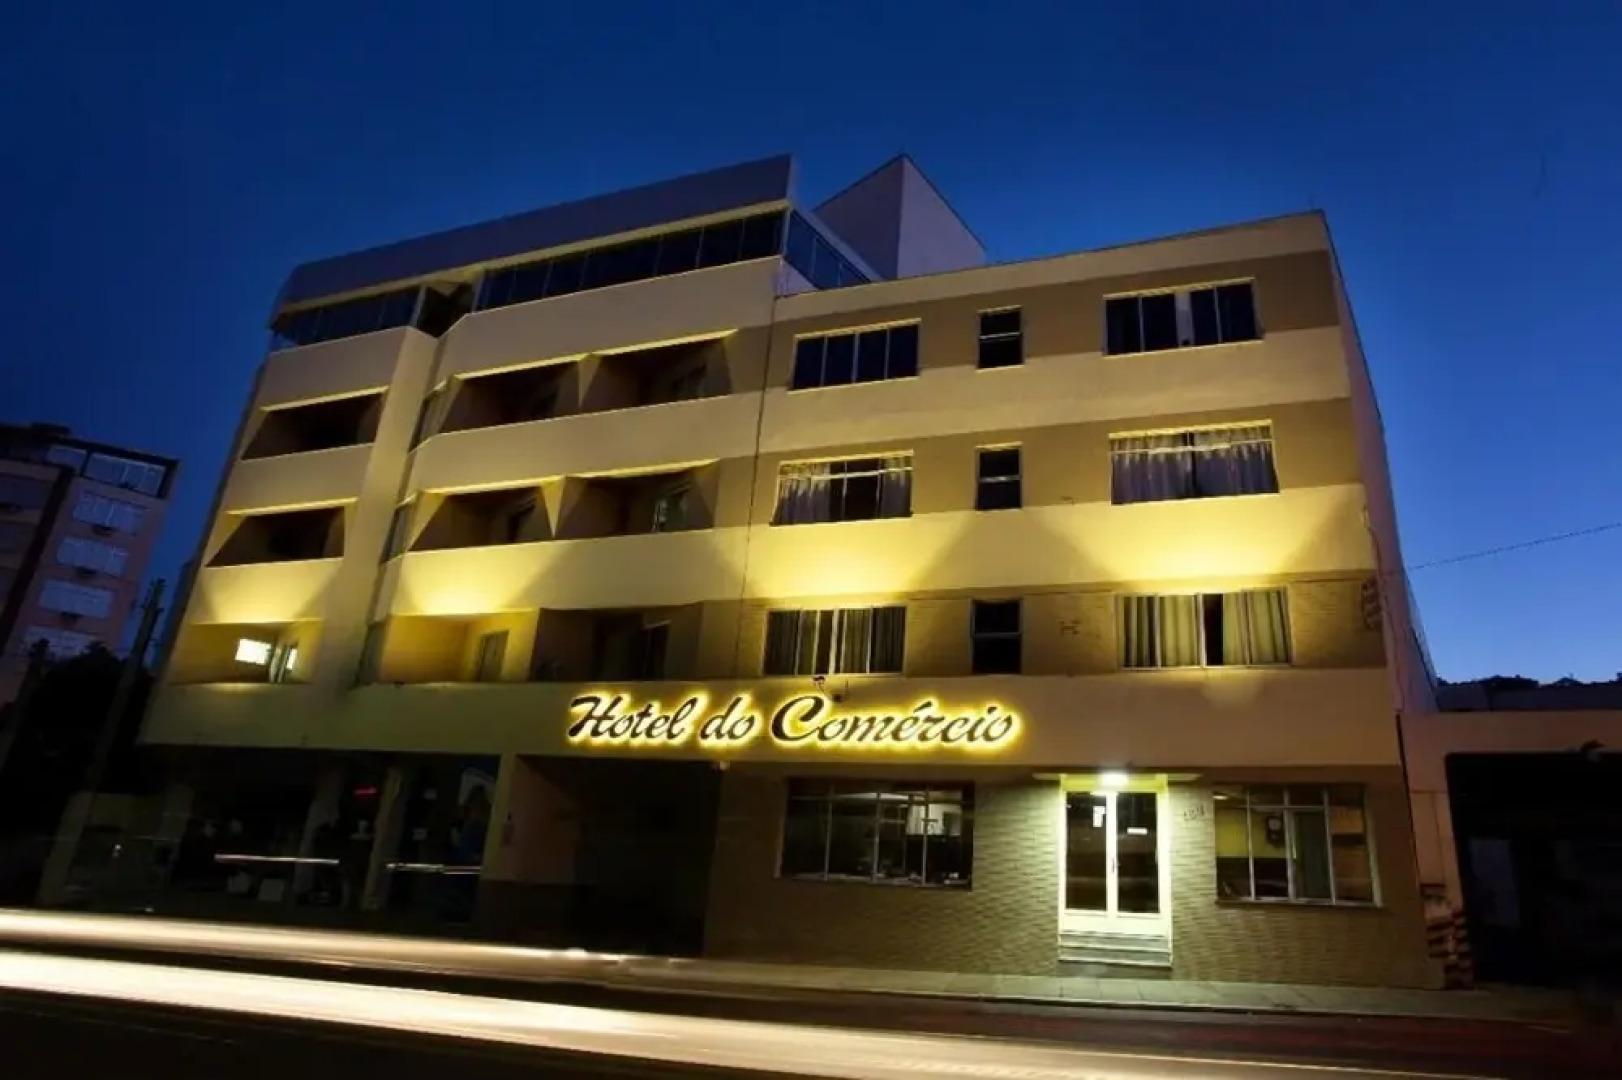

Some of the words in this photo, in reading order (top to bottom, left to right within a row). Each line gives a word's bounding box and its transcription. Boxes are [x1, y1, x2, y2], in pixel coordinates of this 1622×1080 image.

[567, 695, 699, 740] Hotel
[699, 696, 756, 741] do
[771, 695, 1014, 743] Comércio
